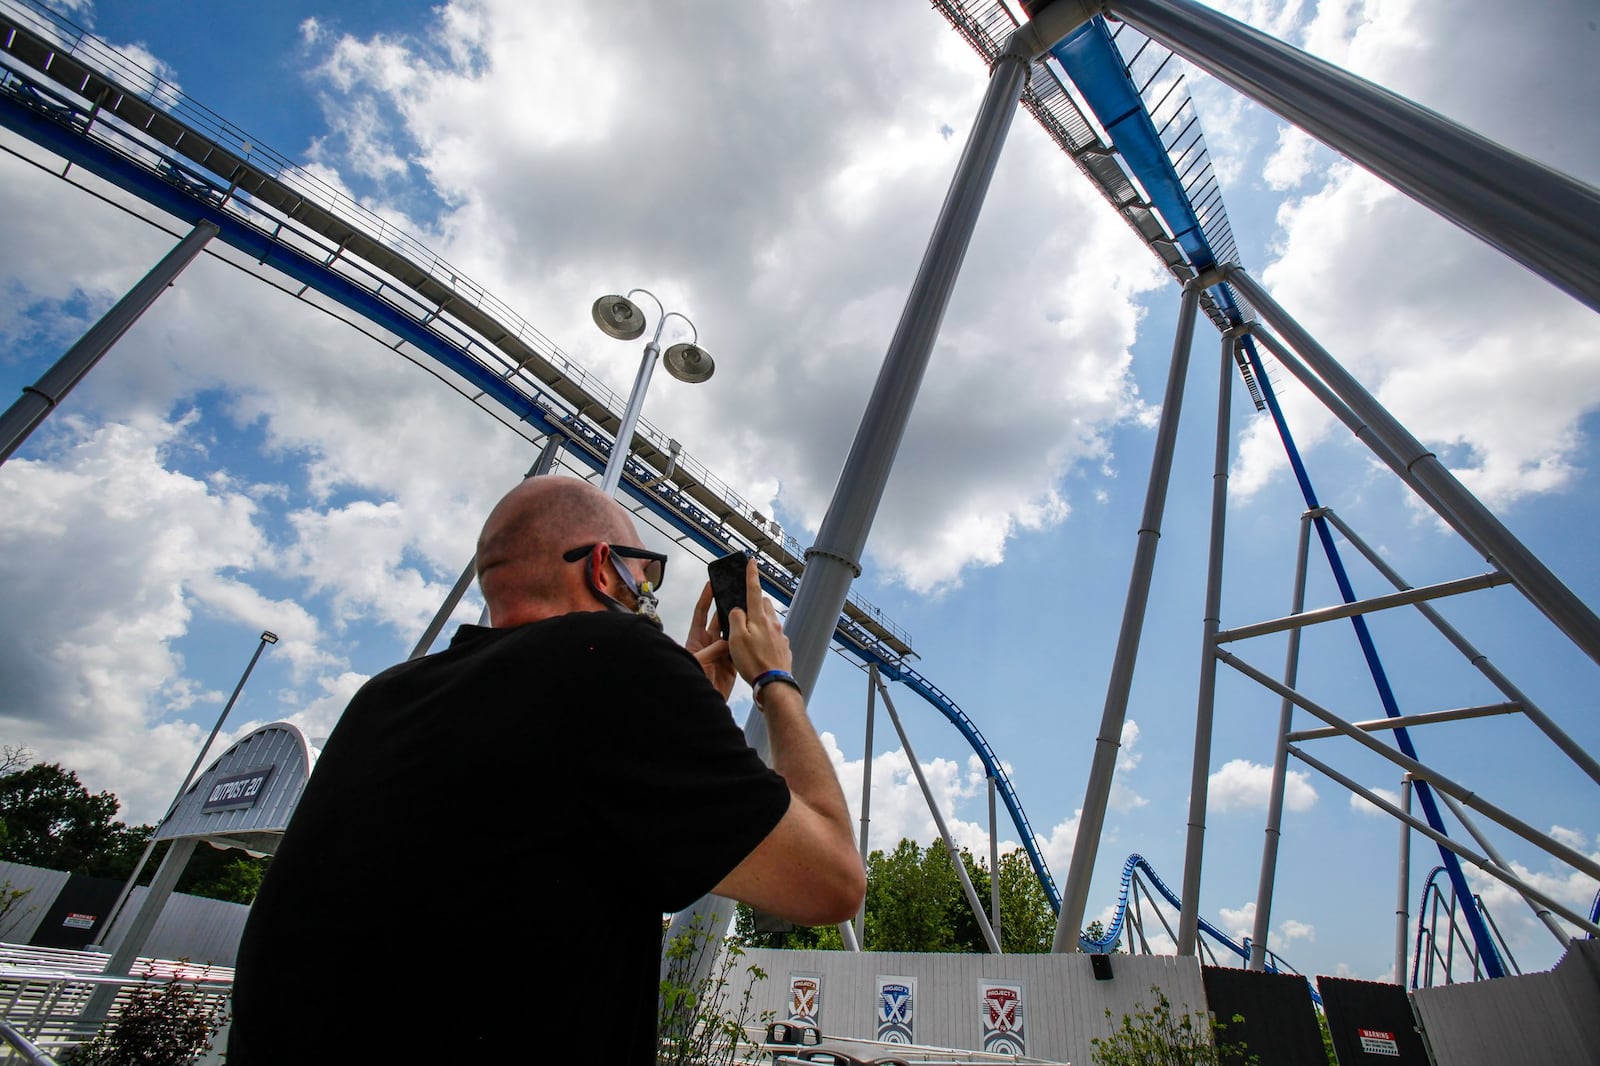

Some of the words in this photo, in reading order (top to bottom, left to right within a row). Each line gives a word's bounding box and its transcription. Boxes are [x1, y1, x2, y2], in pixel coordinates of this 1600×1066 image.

[208, 778, 251, 802] OUTPOST
[244, 777, 264, 797] 20
[1363, 1029, 1389, 1040] WARNING
